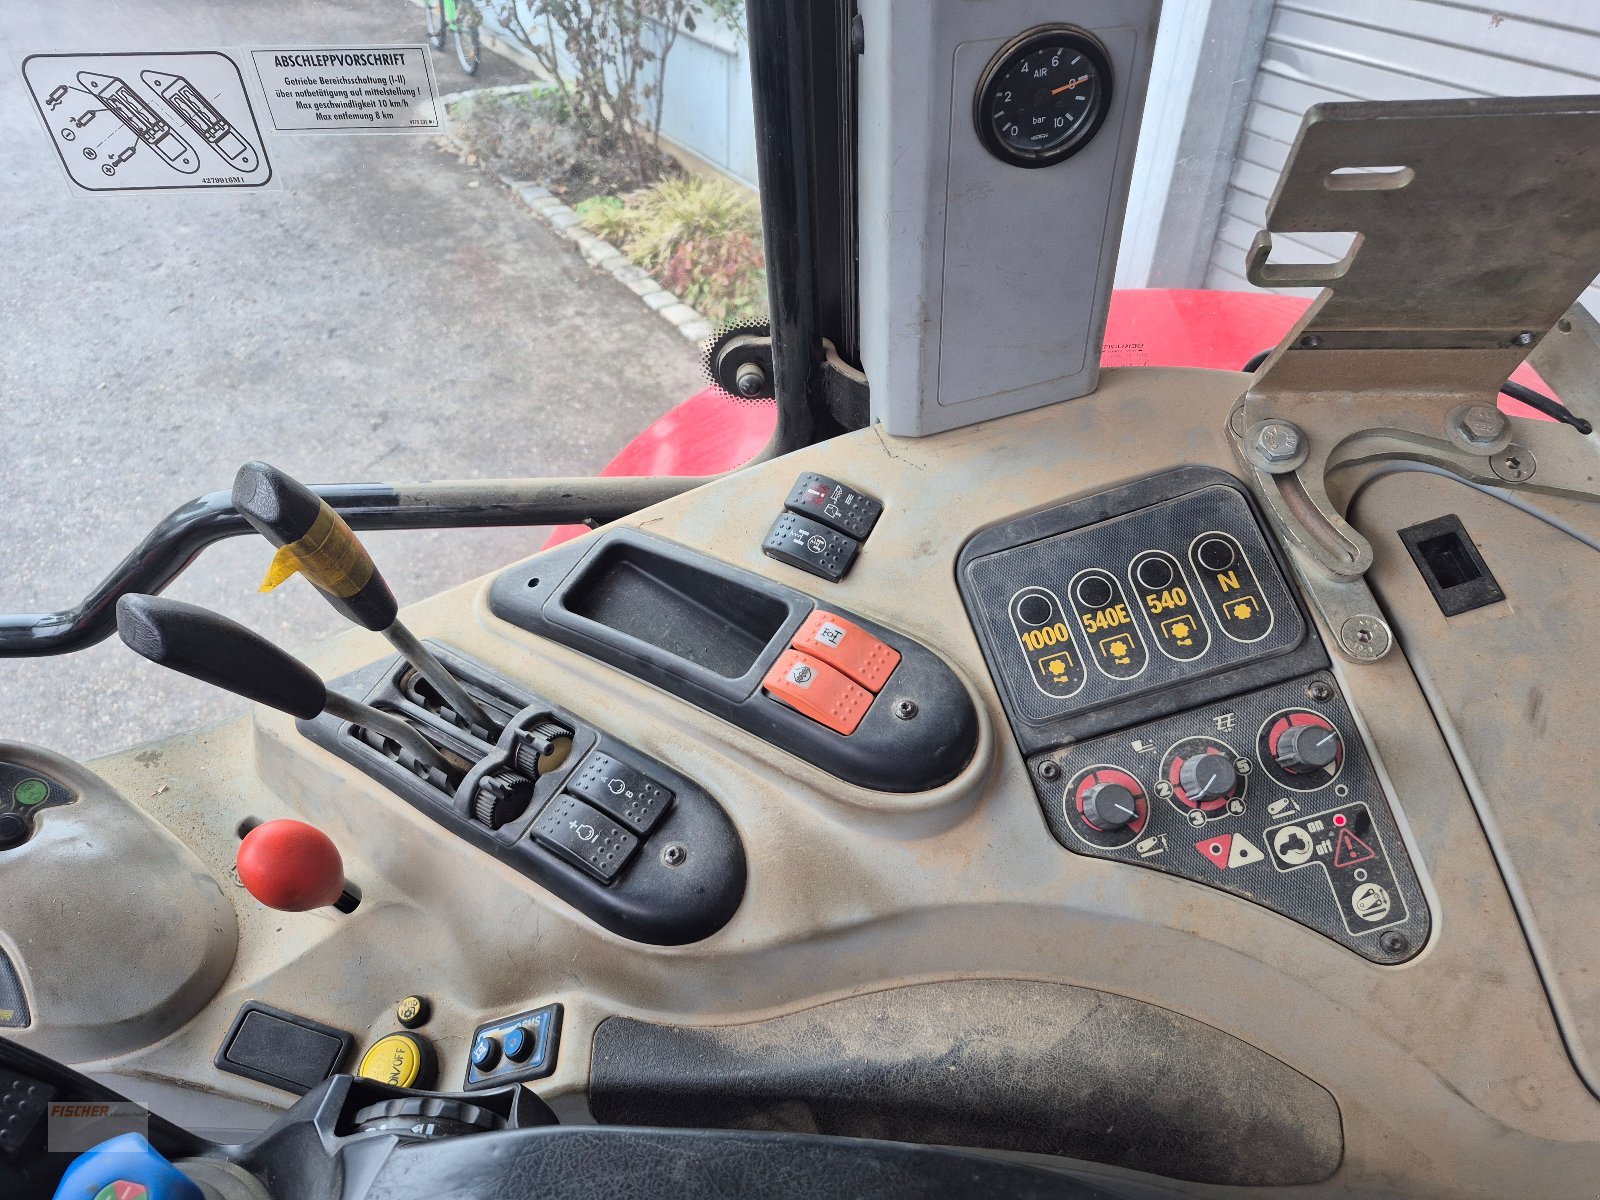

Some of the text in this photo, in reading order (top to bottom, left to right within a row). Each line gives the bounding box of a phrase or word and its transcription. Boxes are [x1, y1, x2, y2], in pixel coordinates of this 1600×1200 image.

[274, 53, 405, 67] ABSCHLEPPVORSCHRIFT
[1052, 56, 1059, 67] 6
[1021, 62, 1029, 73] 4
[1033, 67, 1047, 78] AIR
[284, 76, 318, 86] Getriebe
[319, 76, 387, 87] Bereichsschaltung
[275, 90, 293, 98] über
[295, 88, 349, 98] notbetätigung
[350, 88, 362, 97] auf
[364, 87, 416, 98] mittelstellung
[1004, 91, 1012, 102] 2
[296, 101, 312, 109] Max
[378, 99, 387, 108] 10
[389, 98, 409, 108] km/h
[315, 112, 332, 121] Max
[375, 111, 381, 119] 8
[382, 110, 394, 119] km
[1032, 116, 1046, 125] bar
[1053, 117, 1064, 128] 10
[1011, 126, 1018, 136] 0
[1217, 570, 1241, 593] N
[1146, 587, 1187, 614] 540
[1082, 603, 1131, 634] 540E
[1021, 622, 1069, 652] 1000
[1236, 759, 1250, 774] 5
[1156, 782, 1171, 797] 2
[1230, 800, 1243, 813] 4
[1190, 810, 1204, 825] 3
[1307, 819, 1325, 833] on
[1315, 839, 1333, 856] off
[389, 1048, 405, 1086] ON/OFF
